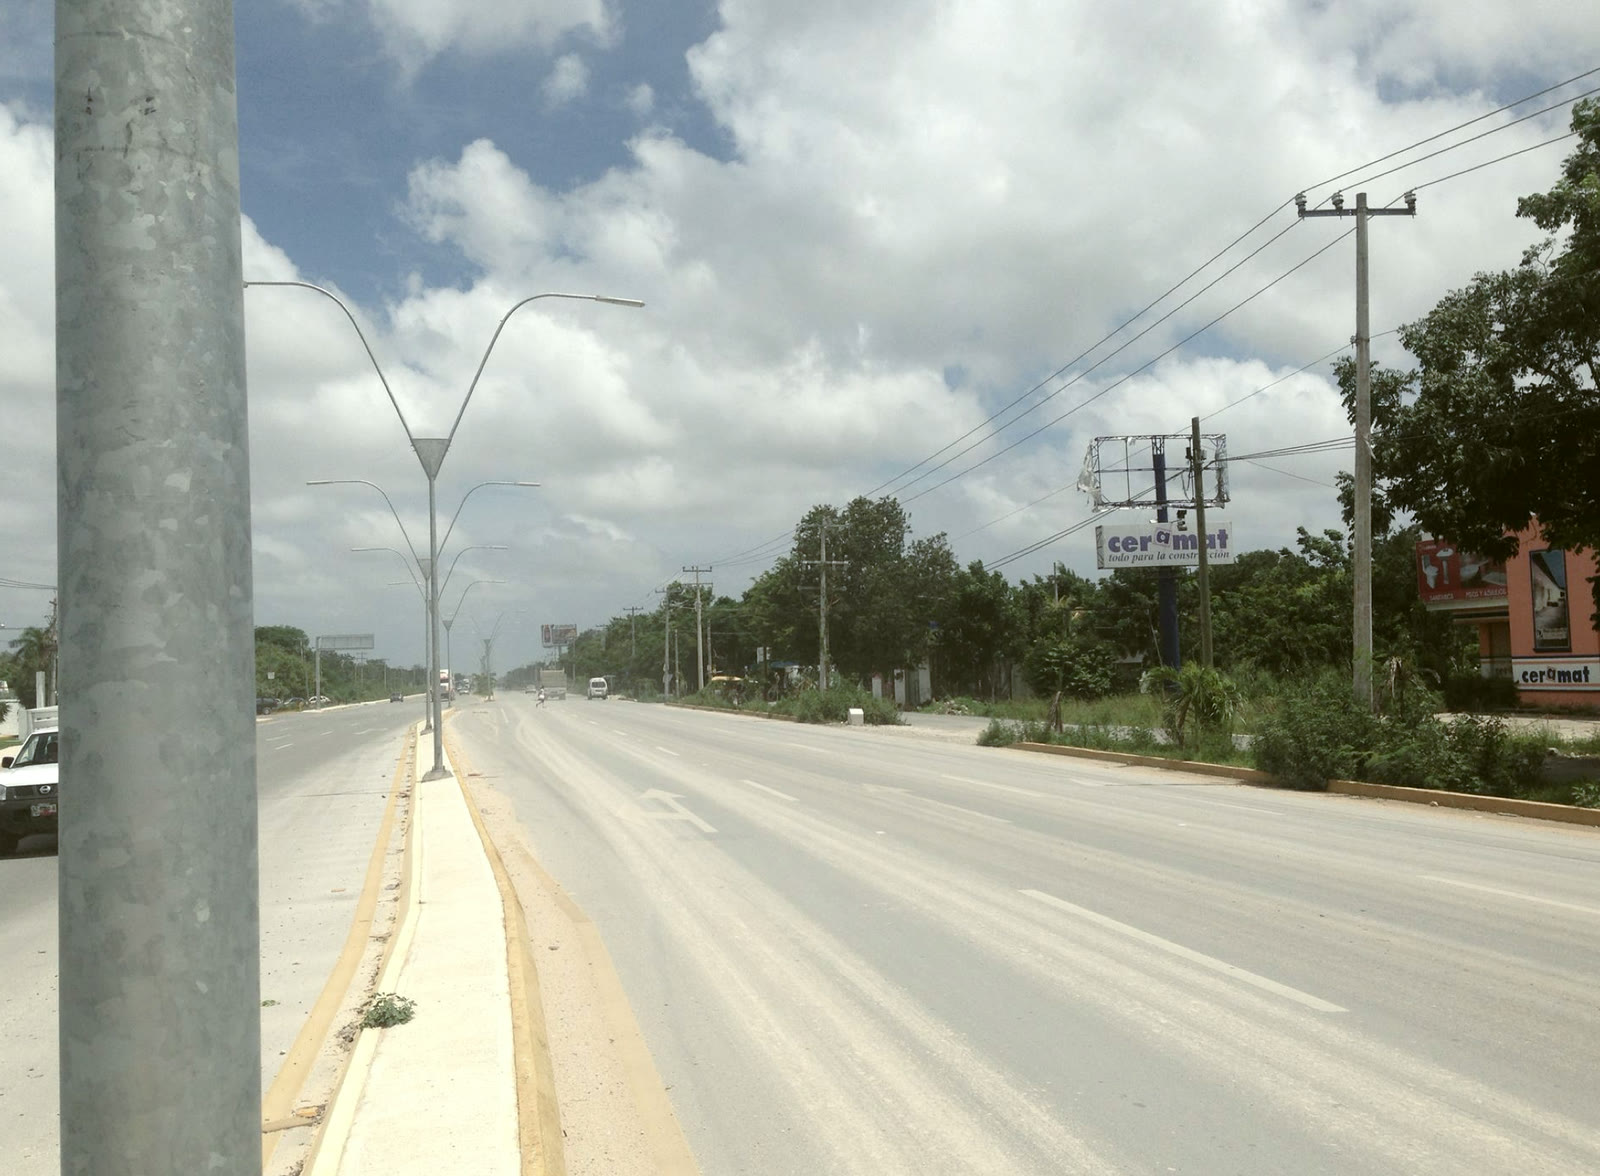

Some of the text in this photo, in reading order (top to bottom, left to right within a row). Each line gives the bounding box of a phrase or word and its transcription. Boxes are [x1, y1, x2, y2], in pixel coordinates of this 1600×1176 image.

[1108, 529, 1228, 553] ceramat
[1109, 550, 1230, 564] todo para la constrción
[1521, 666, 1590, 683] ceramat
